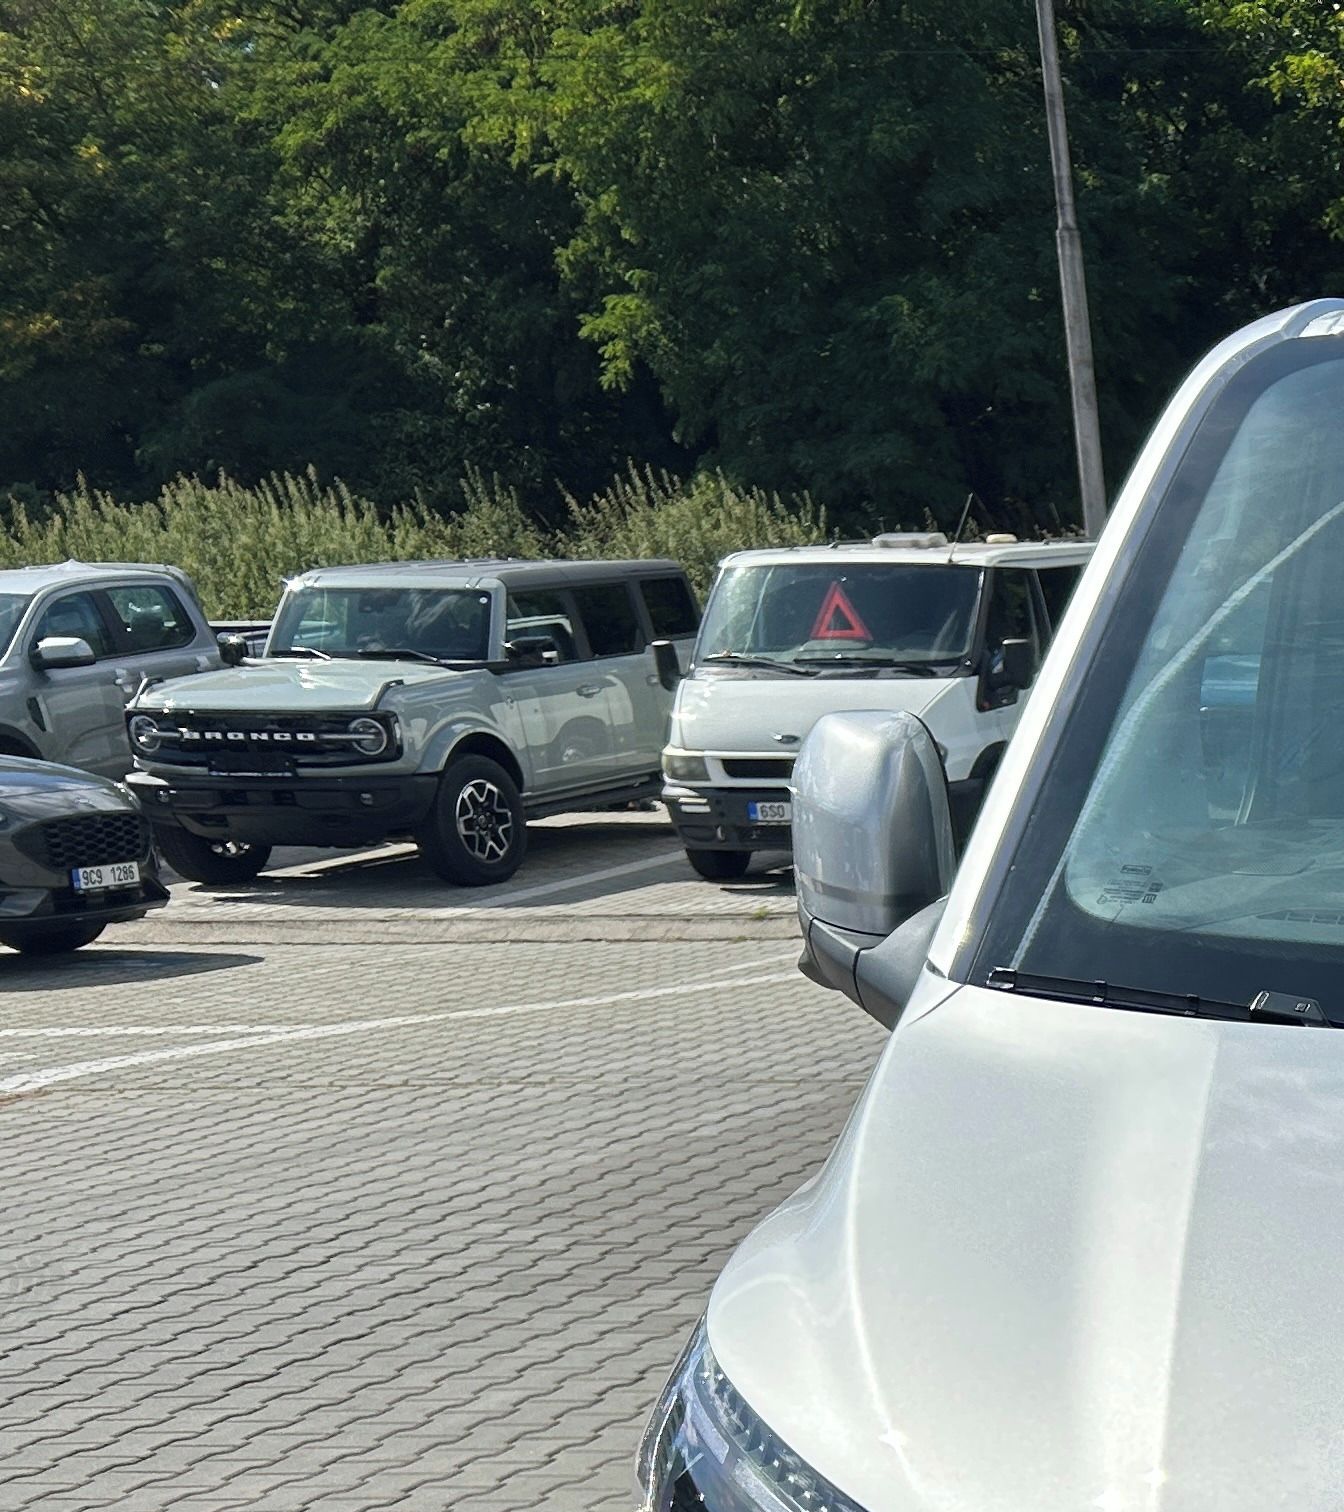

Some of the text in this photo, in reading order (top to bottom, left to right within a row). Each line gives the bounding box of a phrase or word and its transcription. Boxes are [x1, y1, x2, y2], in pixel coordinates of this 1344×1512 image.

[181, 731, 316, 741] BRONCO
[82, 864, 135, 886] 9C9 1286
